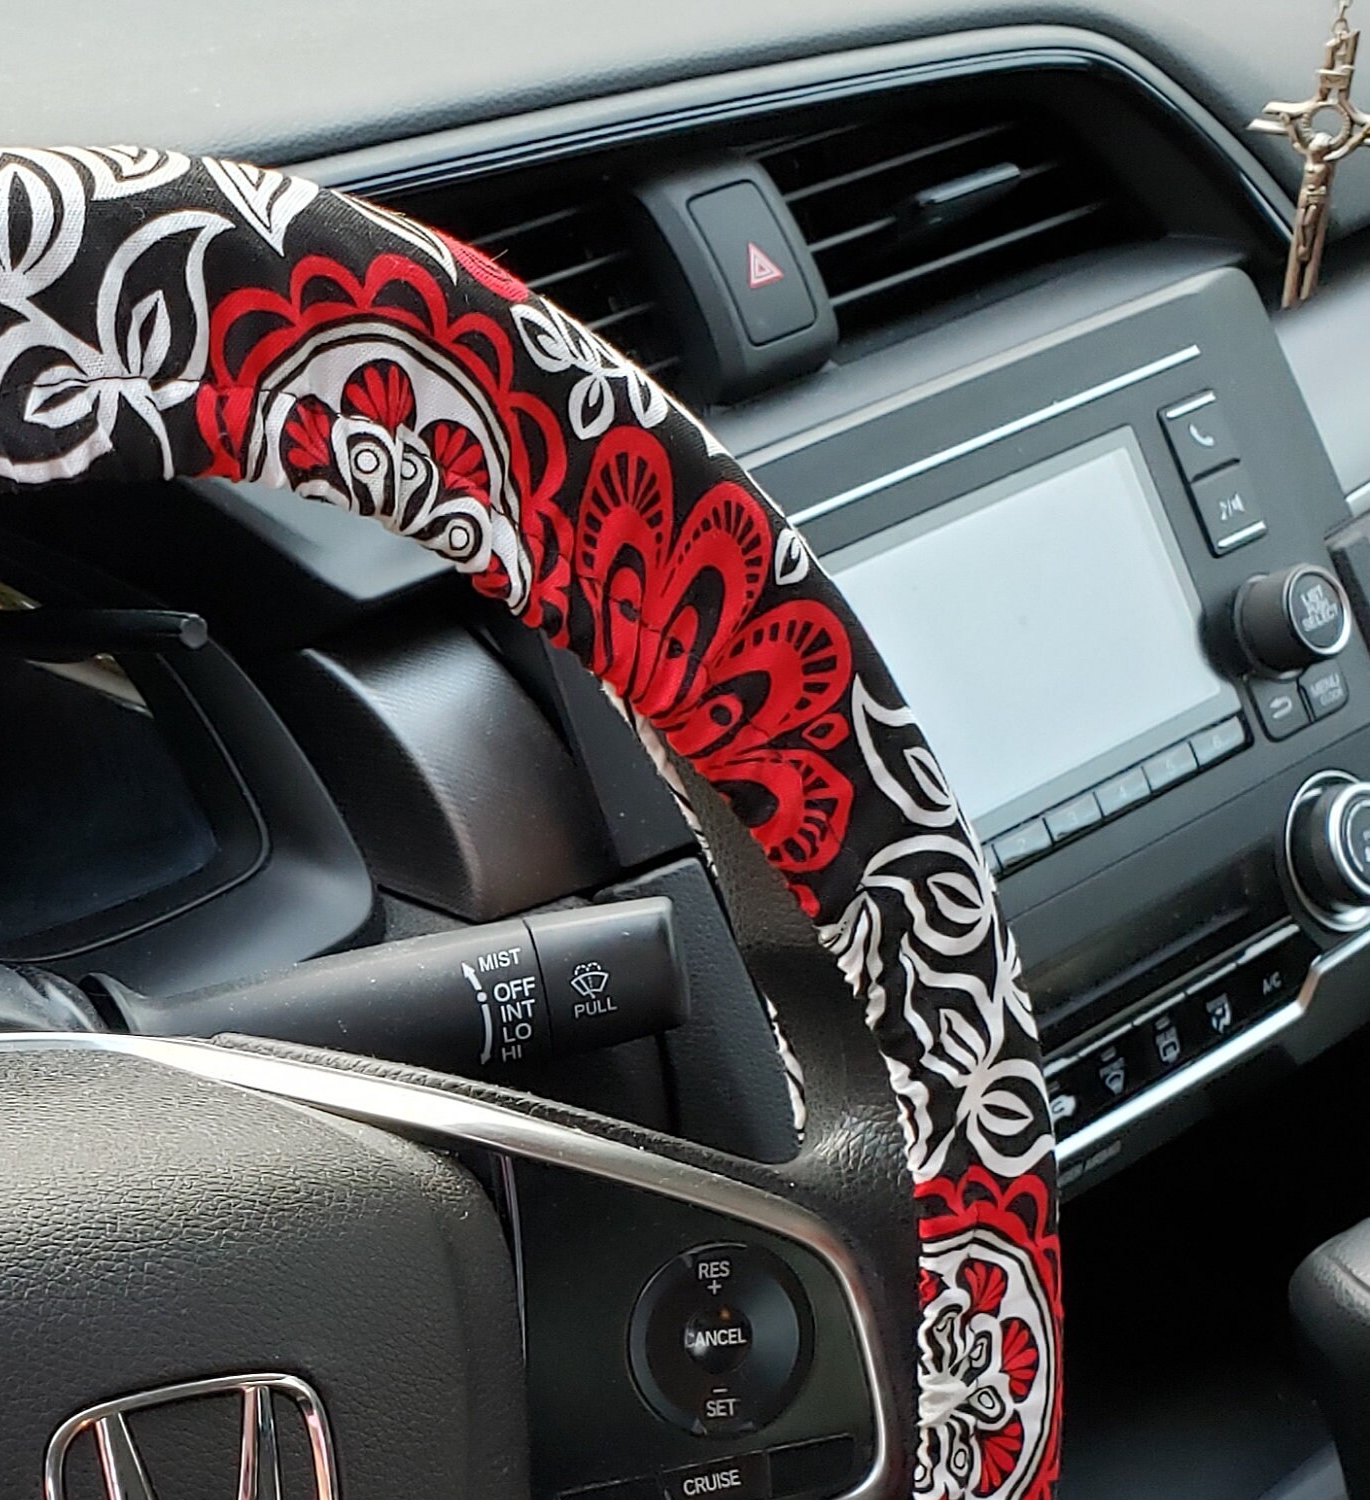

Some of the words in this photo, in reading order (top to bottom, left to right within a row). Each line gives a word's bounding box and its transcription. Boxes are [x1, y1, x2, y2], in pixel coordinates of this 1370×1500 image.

[477, 948, 521, 973] MIST
[493, 976, 536, 1003] OFF
[1261, 971, 1283, 996] A/C
[499, 999, 535, 1023] INT
[574, 997, 618, 1020] PULL
[503, 1023, 532, 1044] LO
[502, 1044, 523, 1063] HI
[698, 1261, 730, 1279] RES
[684, 1327, 748, 1348] CANCEL
[706, 1398, 737, 1417] SET
[683, 1469, 742, 1497] CRUISE
